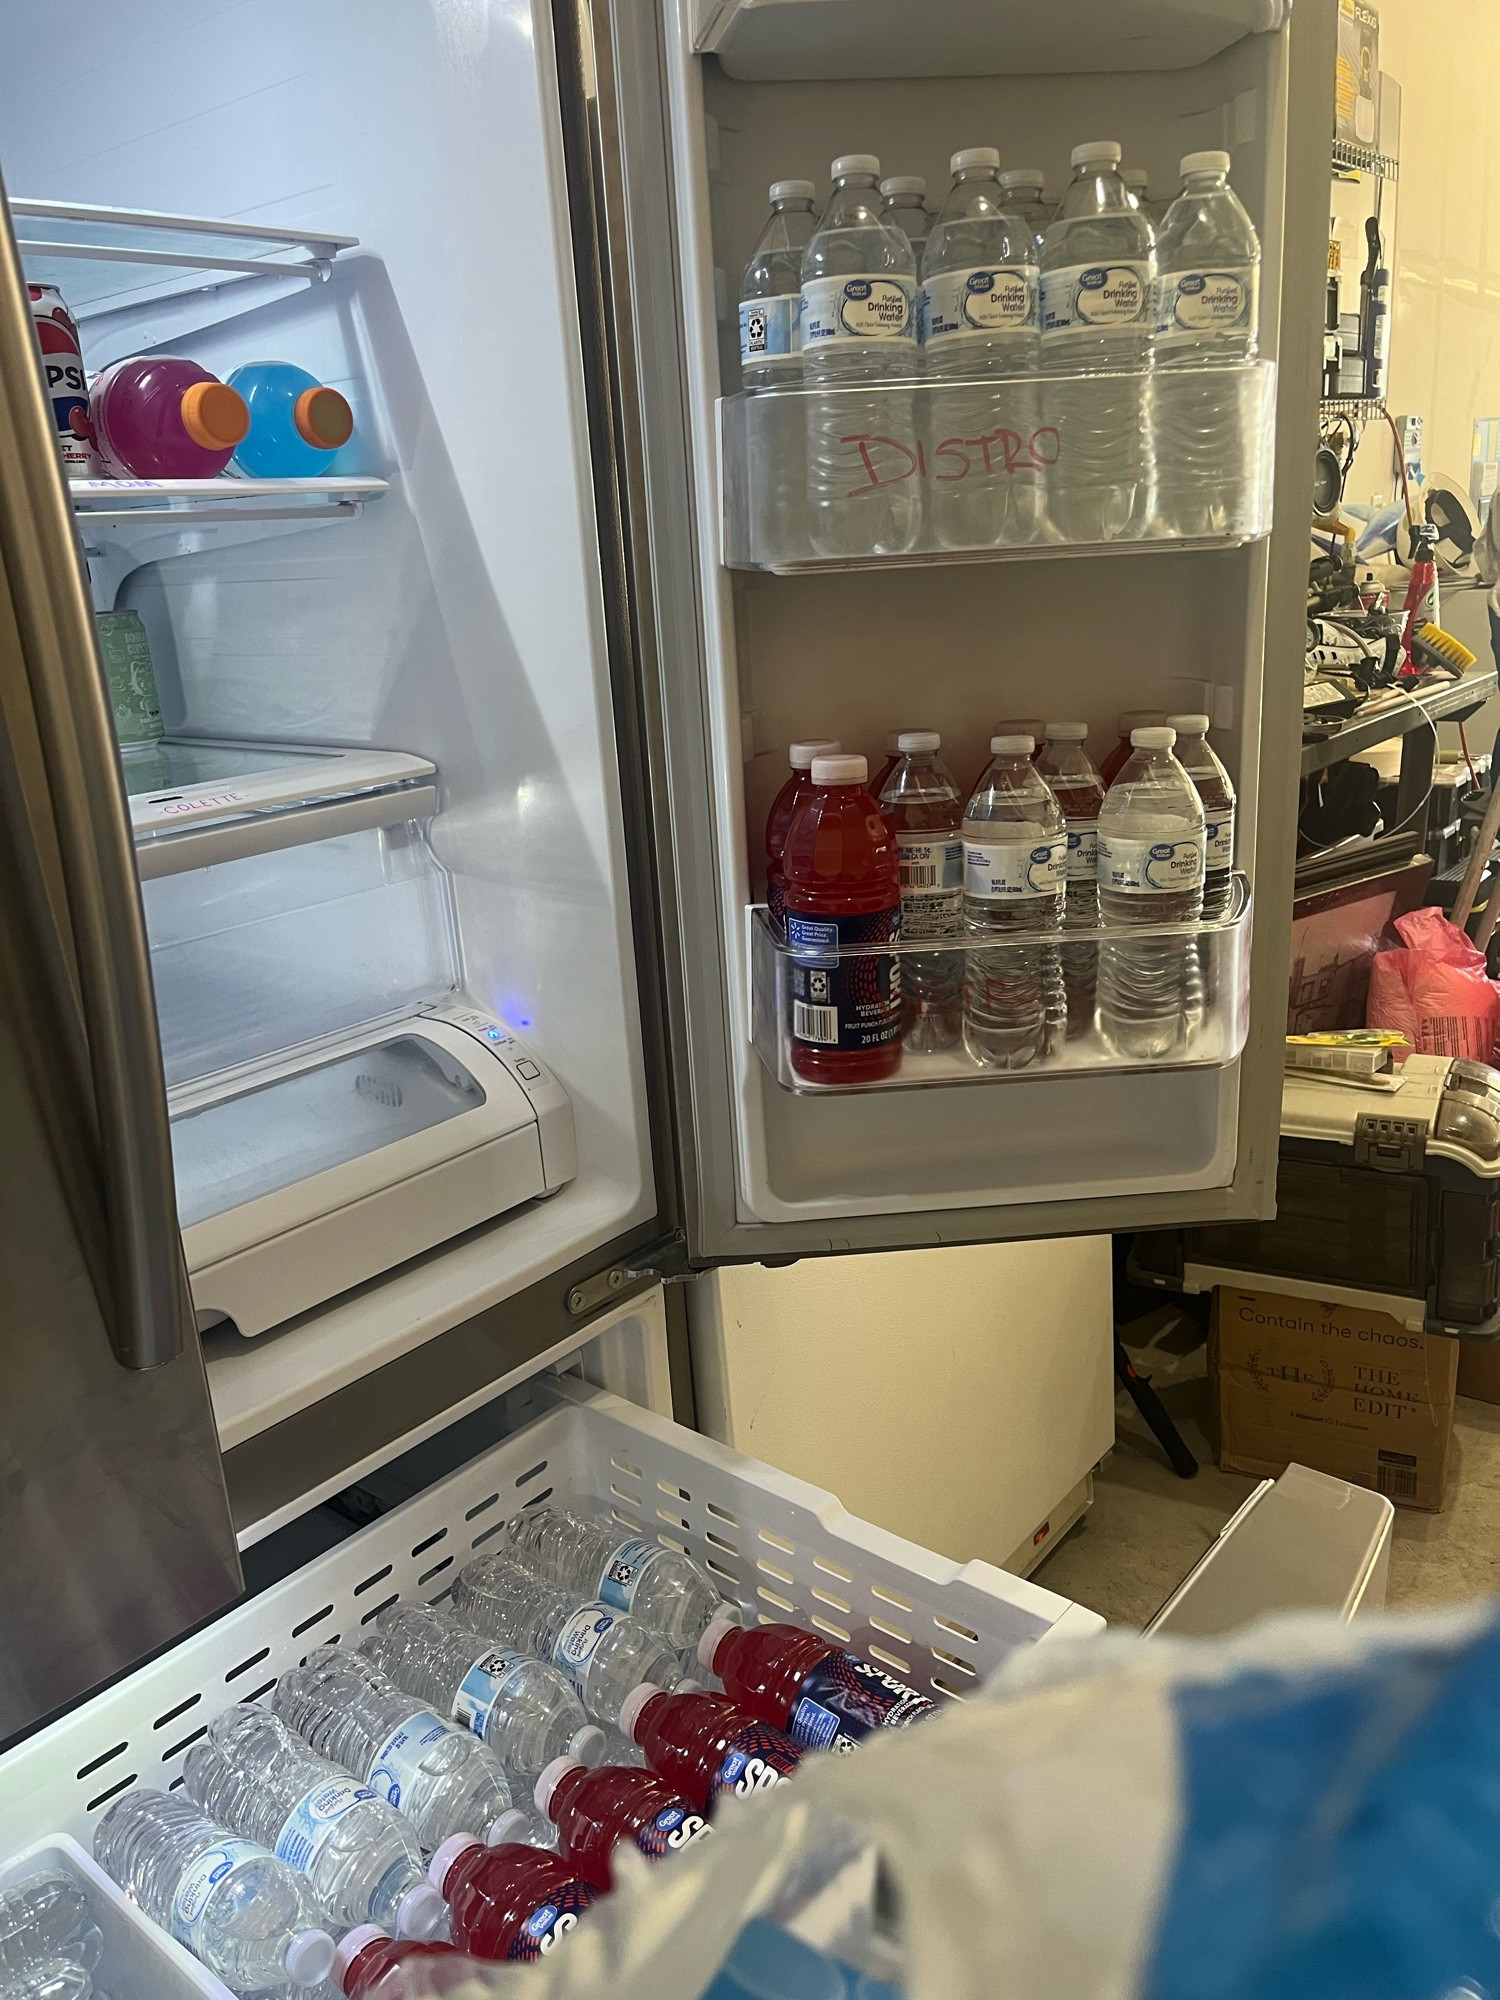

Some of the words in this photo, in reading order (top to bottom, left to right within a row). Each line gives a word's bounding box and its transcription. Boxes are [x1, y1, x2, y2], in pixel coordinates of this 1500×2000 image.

[969, 275, 989, 286] Great
[846, 284, 868, 293] Great
[990, 294, 1025, 304] Drinking
[1103, 289, 1138, 300] Drinking
[1201, 295, 1239, 305] Drinking
[867, 302, 904, 314] Drinking
[1002, 303, 1025, 312] Water
[1115, 299, 1138, 308] Water
[878, 312, 904, 323] Water
[45, 365, 87, 391] PSI
[64, 452, 92, 460] HERRY
[840, 427, 1061, 498] DISTRO
[1032, 850, 1049, 858] Great
[1151, 847, 1171, 855] Great
[1170, 859, 1198, 869] Drinking
[813, 926, 835, 934] Quality.
[861, 1035, 871, 1044] 20
[872, 1034, 880, 1043] FL
[880, 1030, 889, 1039] OZ
[1238, 1306, 1314, 1333] Contain
[1320, 1322, 1351, 1338] the
[1358, 1328, 1424, 1350] chaos.
[1352, 1366, 1401, 1386] THE
[1352, 1382, 1419, 1403] HOME
[571, 1624, 591, 1656] Drinking
[725, 1757, 740, 1778] Great
[318, 1787, 352, 1812] Drinking
[659, 1810, 677, 1827] Great
[184, 1874, 207, 1915] Drinking
[531, 1909, 551, 1931] Great
